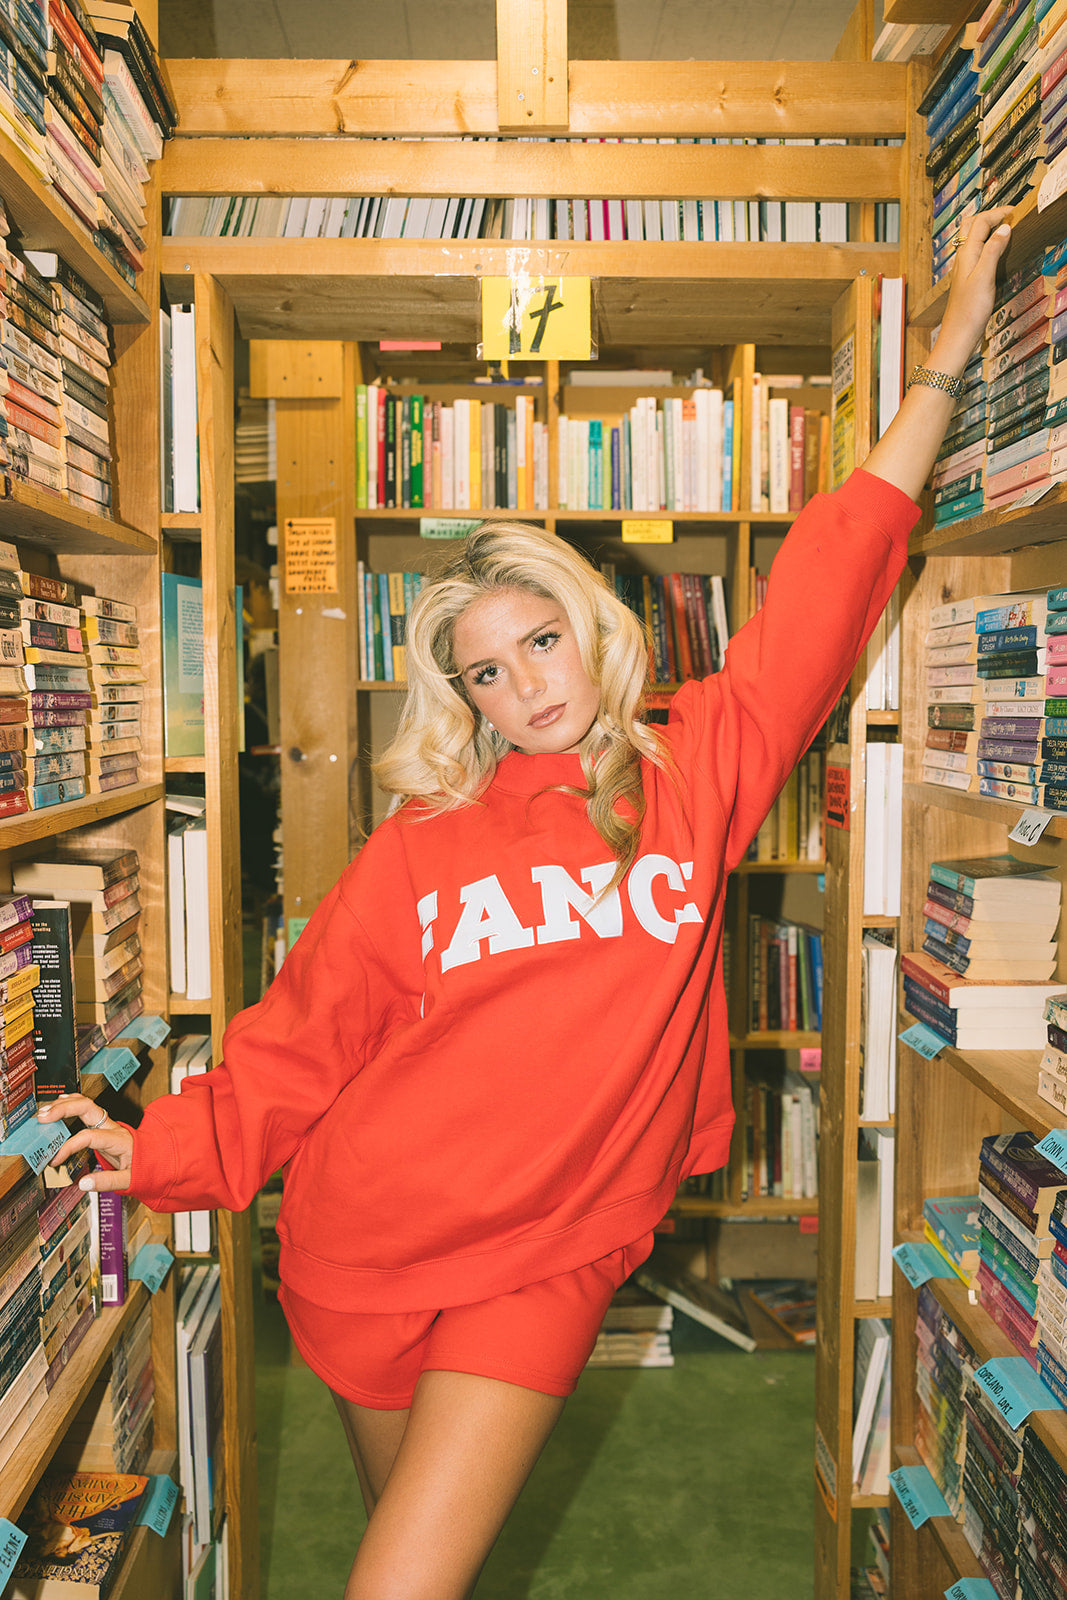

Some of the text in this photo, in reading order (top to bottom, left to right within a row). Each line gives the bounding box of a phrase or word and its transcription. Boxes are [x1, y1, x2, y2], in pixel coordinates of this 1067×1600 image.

[508, 285, 565, 354] 17
[1040, 1136, 1063, 1162] CONN,
[977, 1366, 1013, 1416] COPELAND, LORI
[2, 1532, 21, 1569] ELAINE
